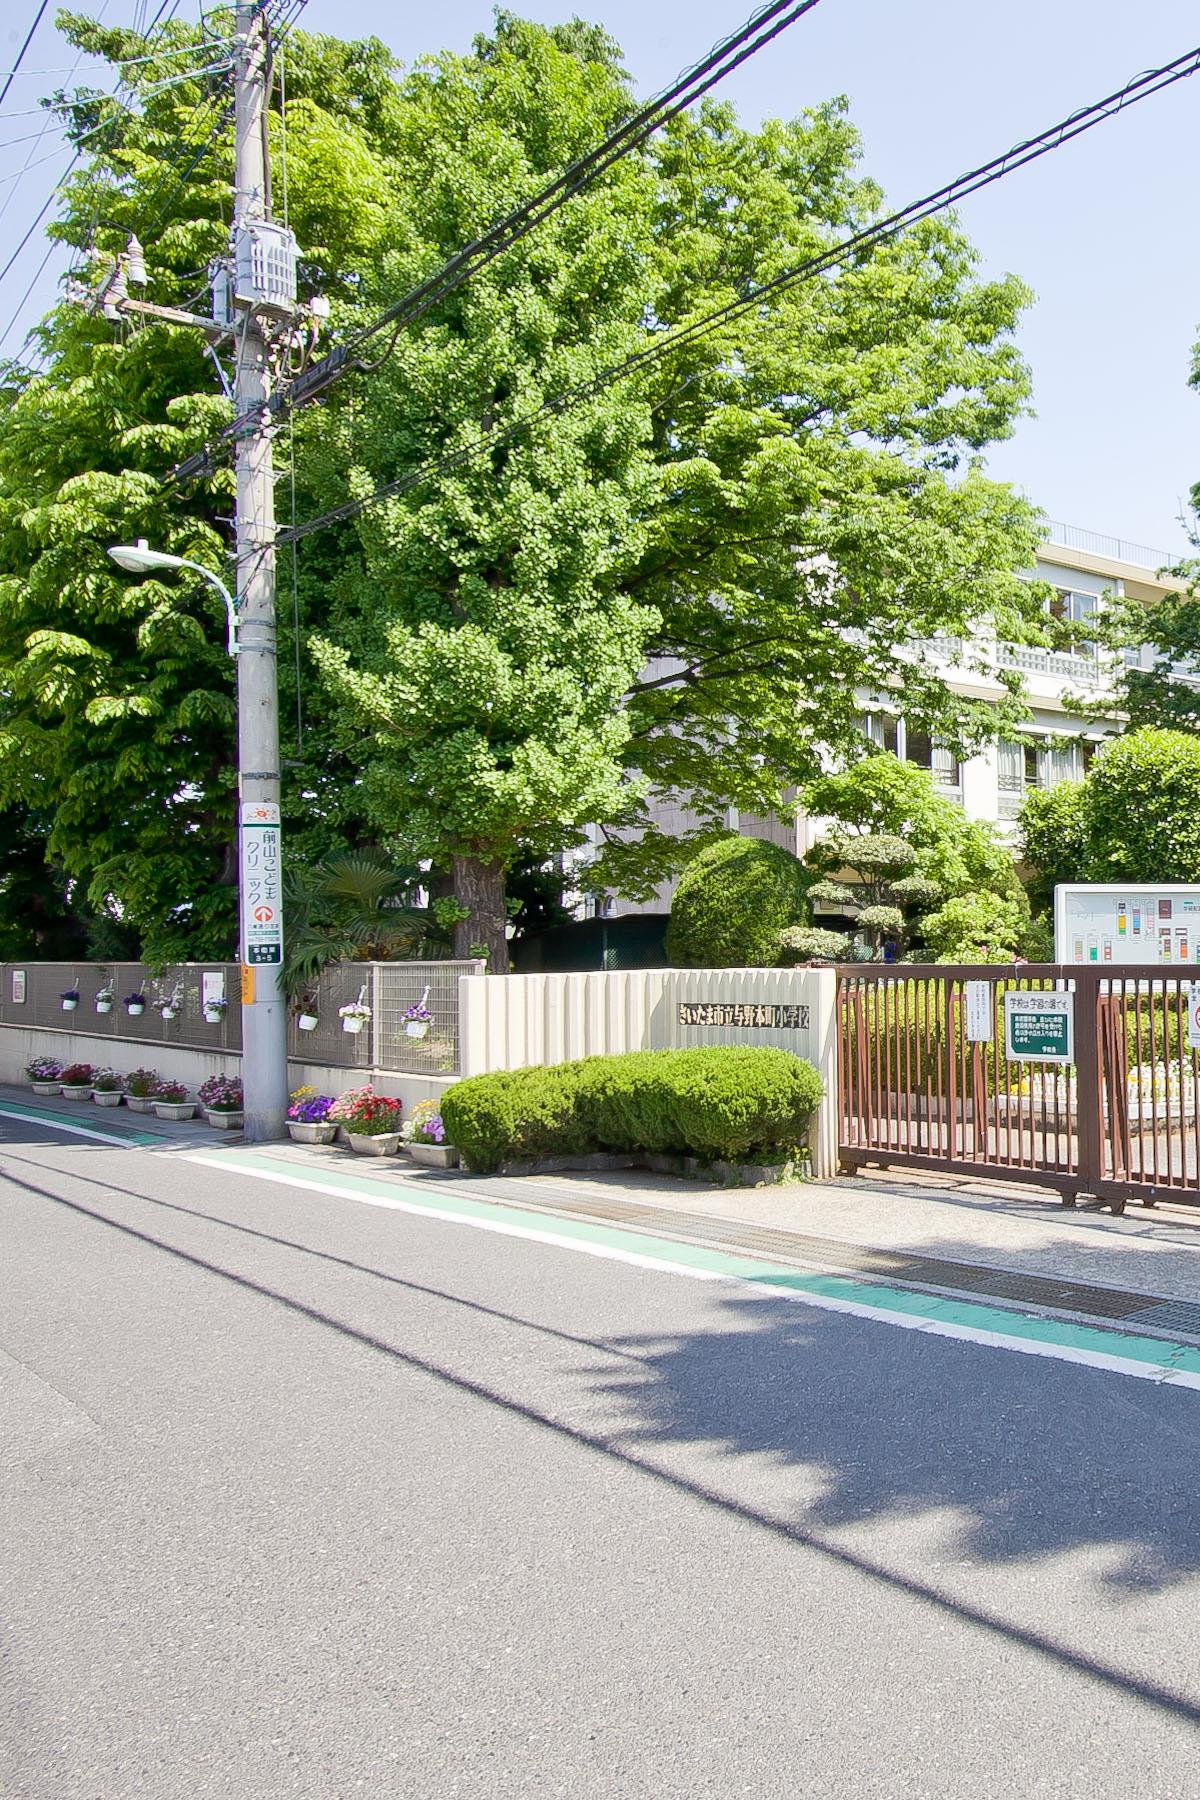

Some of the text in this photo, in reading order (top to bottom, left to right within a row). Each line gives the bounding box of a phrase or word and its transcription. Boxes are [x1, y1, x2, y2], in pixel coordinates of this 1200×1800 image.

[246, 841, 261, 905] クリニック
[262, 830, 278, 900] 前山こども
[679, 1003, 810, 1029] さいたま市立与野本町小学校
